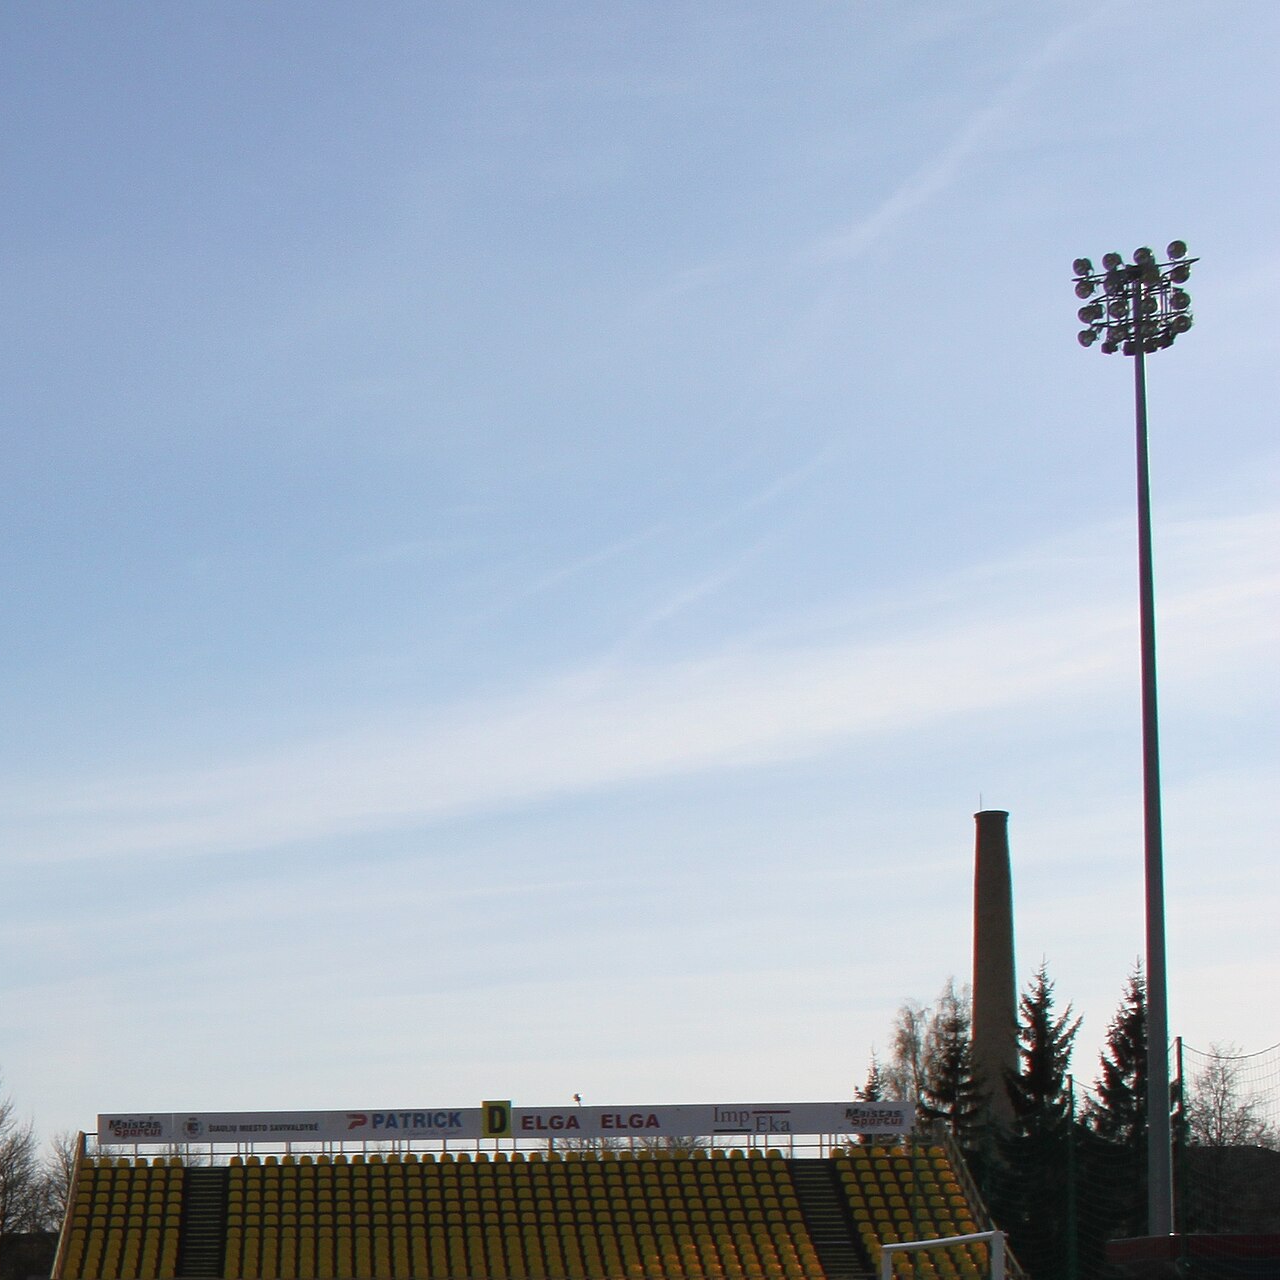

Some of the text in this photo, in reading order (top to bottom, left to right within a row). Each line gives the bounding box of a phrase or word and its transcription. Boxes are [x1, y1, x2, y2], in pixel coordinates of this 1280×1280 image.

[371, 1111, 462, 1129] PATRICK
[488, 1106, 506, 1133] D
[521, 1115, 580, 1130] ELGA
[601, 1114, 660, 1129] ELGA
[713, 1107, 750, 1127] Imp
[755, 1116, 790, 1132] Eka
